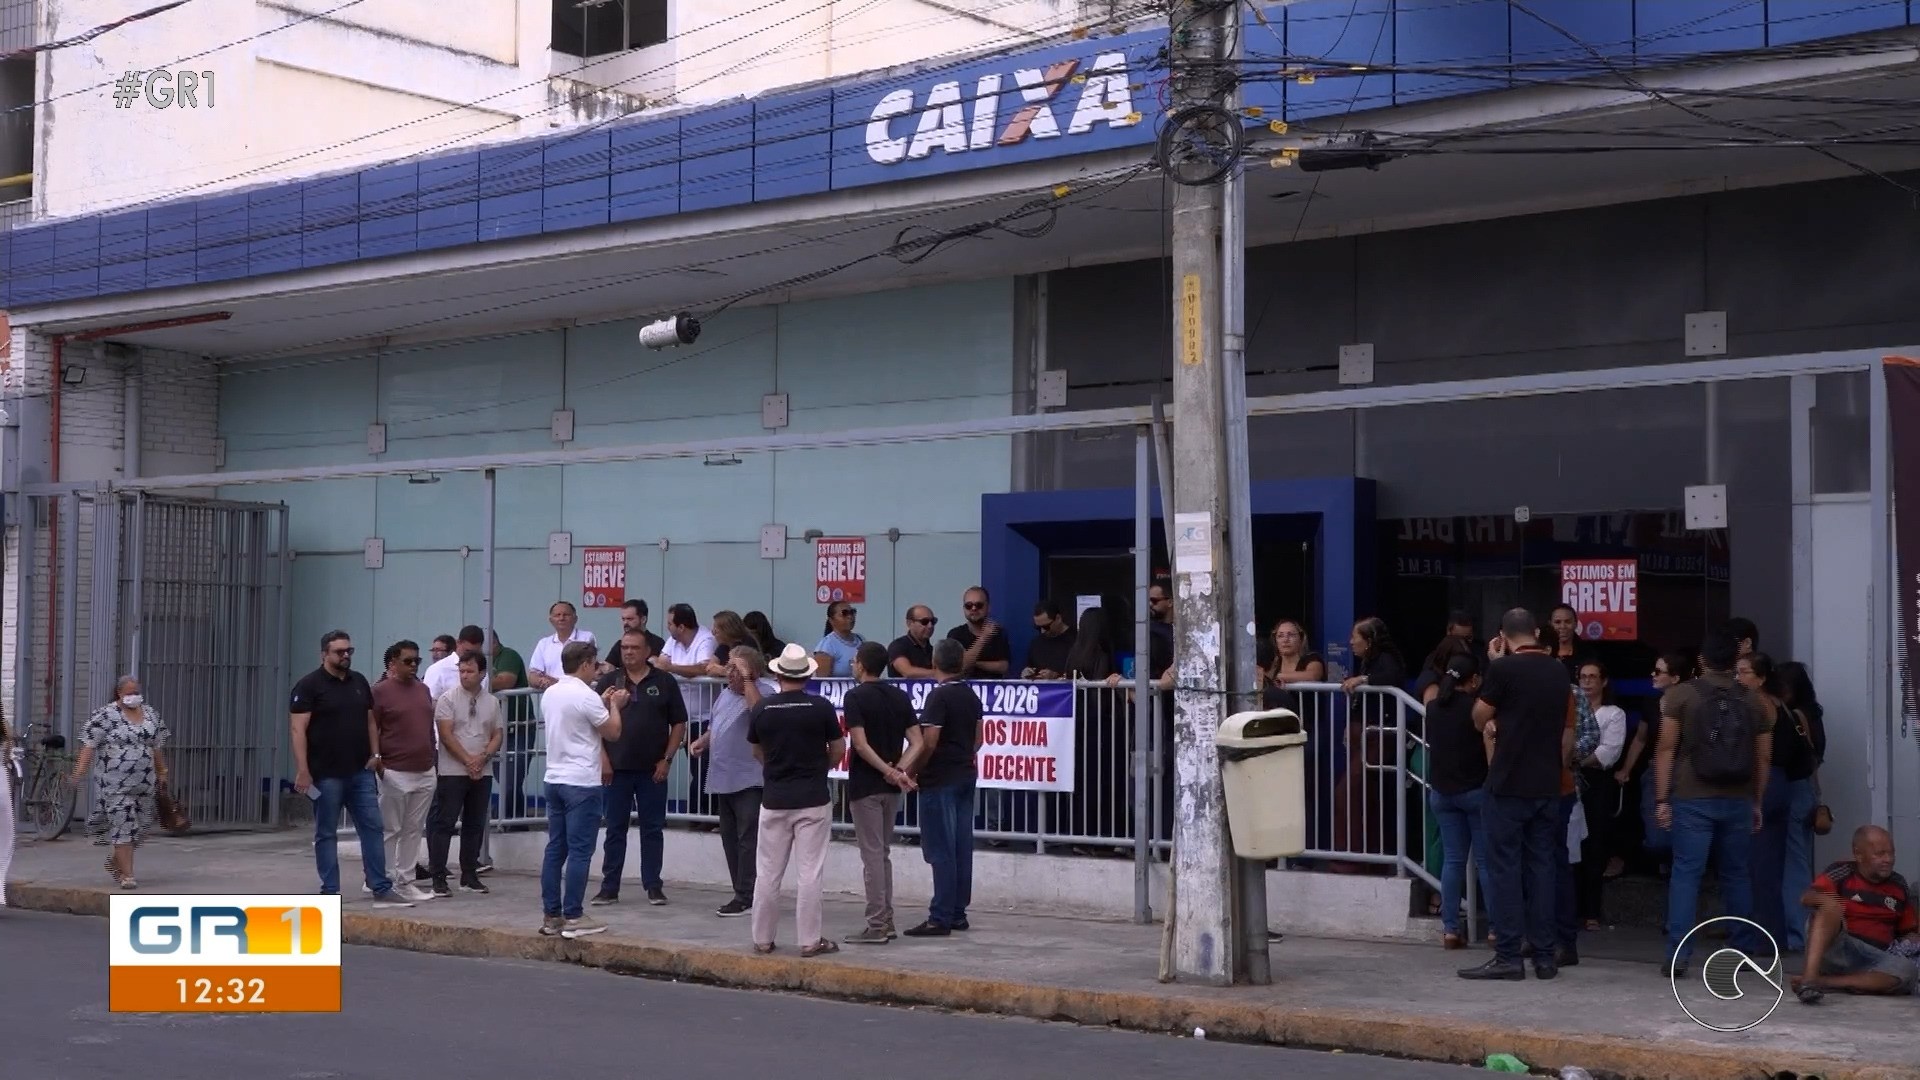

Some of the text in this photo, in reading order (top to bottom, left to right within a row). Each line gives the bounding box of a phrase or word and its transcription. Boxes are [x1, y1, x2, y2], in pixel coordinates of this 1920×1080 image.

[866, 53, 1135, 164] CAIXA
[585, 552, 614, 563] ESTAMOS
[818, 542, 865, 555] ESTAMOS EM
[584, 564, 625, 588] GREVE
[817, 555, 865, 581] GREVE
[1563, 564, 1635, 580] ESTAMOS EM
[1562, 581, 1637, 613] GREVE
[992, 685, 1039, 714] 2026
[1011, 720, 1048, 747] UMA
[983, 754, 1057, 782] DECENTE
